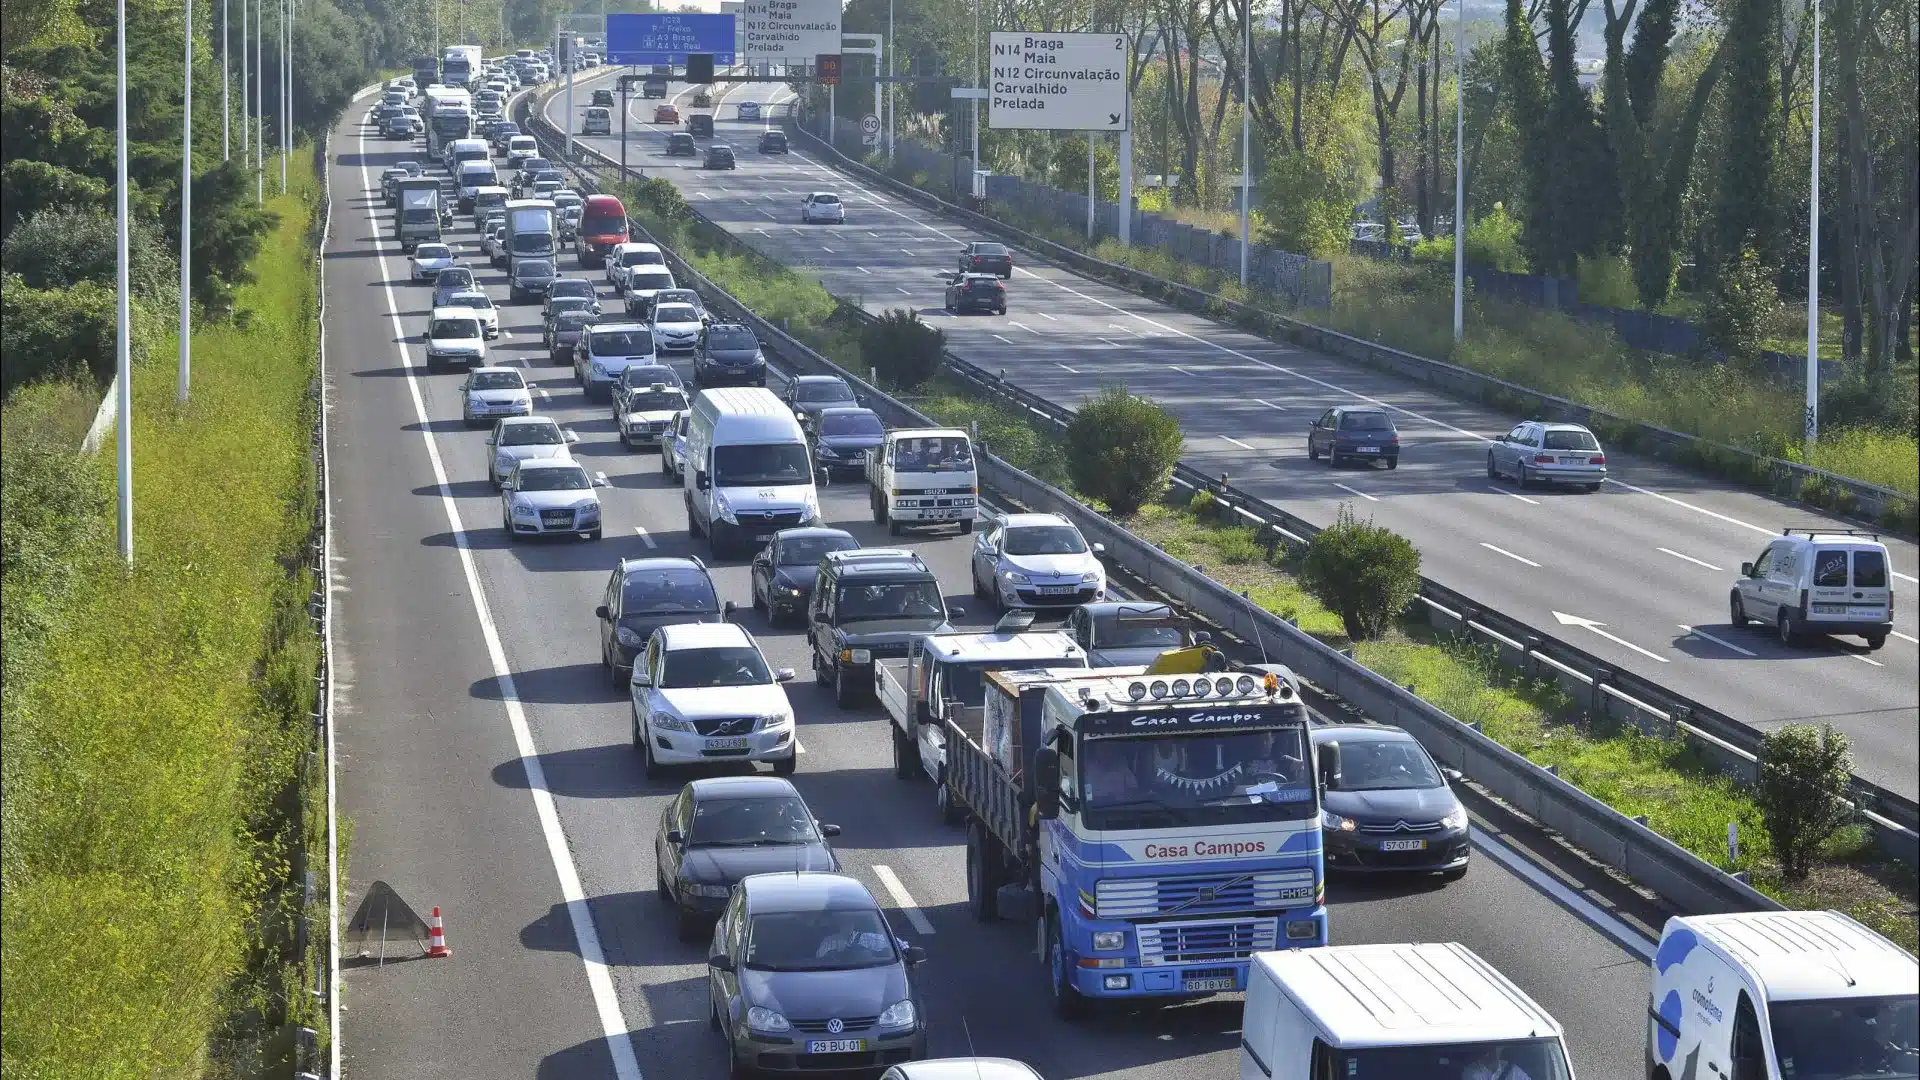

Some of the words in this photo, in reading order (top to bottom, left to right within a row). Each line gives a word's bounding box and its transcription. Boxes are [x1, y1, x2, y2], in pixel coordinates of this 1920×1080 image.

[769, 1, 797, 10] Braga
[769, 11, 792, 19] Maia
[768, 22, 837, 32] Circunvalação
[672, 34, 695, 42] Braga
[748, 32, 800, 41] Carvalhido
[748, 43, 785, 52] Prelada
[1024, 37, 1064, 50] Braga
[1115, 38, 1123, 50] 2
[1024, 53, 1056, 64] Maia
[1024, 68, 1120, 82] Circunvalação
[994, 82, 1068, 95] Carvalhido
[994, 97, 1045, 110] Prelada
[864, 120, 878, 129] 80
[1131, 716, 1178, 727] Casa
[1188, 712, 1262, 724] Campos
[1145, 844, 1189, 859] Casa
[1194, 841, 1266, 857] Campos
[1280, 887, 1309, 900] FH12
